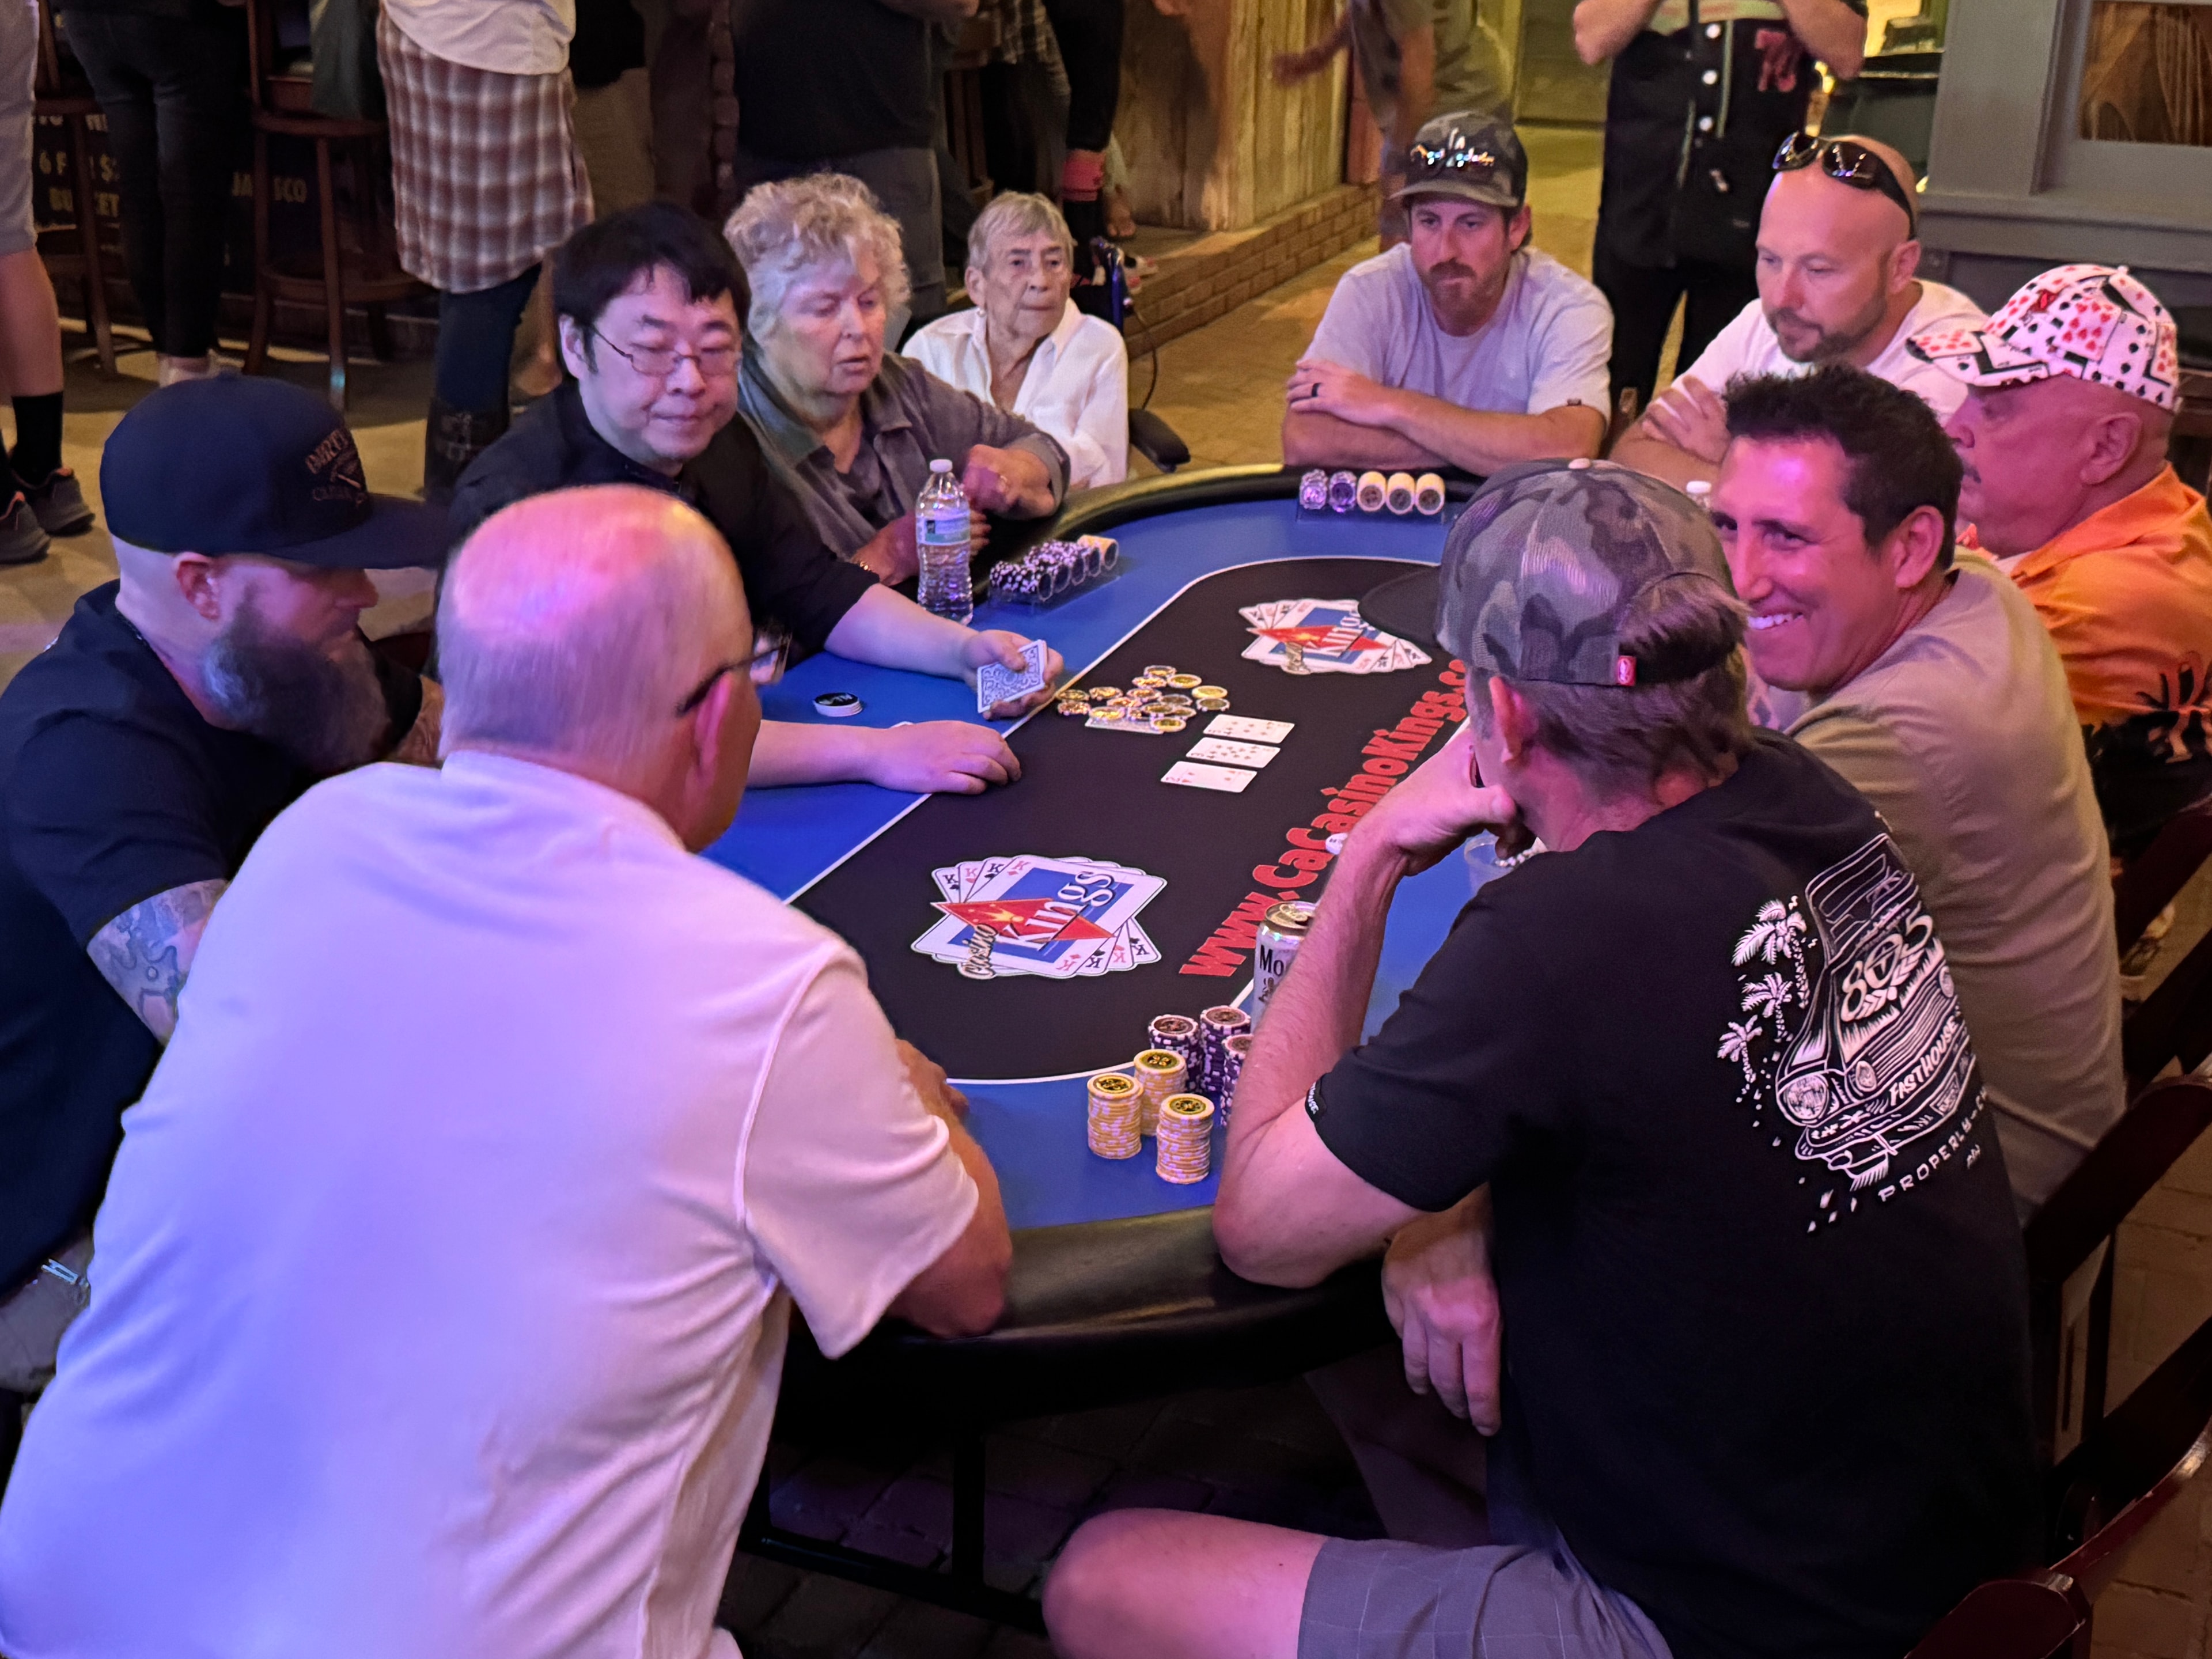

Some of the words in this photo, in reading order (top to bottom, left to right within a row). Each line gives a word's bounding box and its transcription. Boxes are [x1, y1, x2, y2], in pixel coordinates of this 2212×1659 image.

[942, 873, 959, 884] K
[965, 868, 978, 877] K
[987, 863, 1005, 873] K
[1012, 860, 1031, 871] K
[995, 870, 1116, 952] Kings
[960, 924, 998, 979] Casino
[1259, 945, 1285, 977] Mo
[1840, 900, 1933, 1022] 805
[1889, 1015, 1957, 1106] FASTHOUSE
